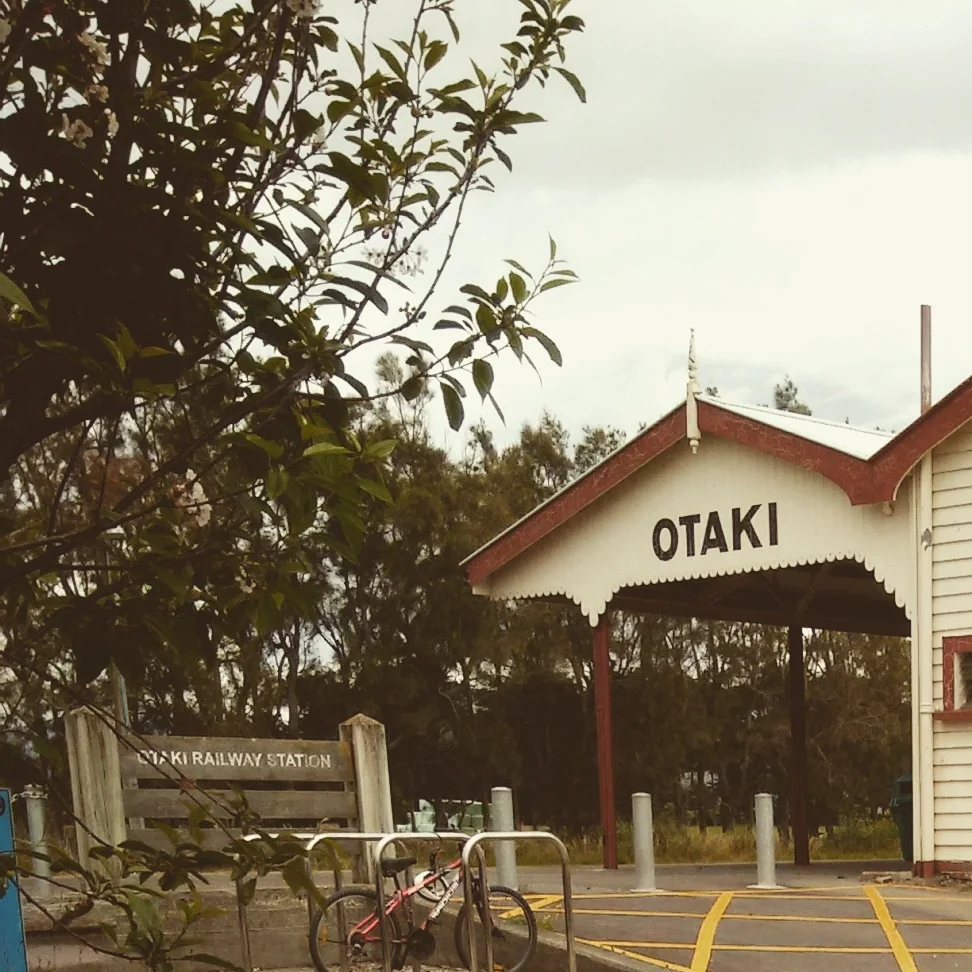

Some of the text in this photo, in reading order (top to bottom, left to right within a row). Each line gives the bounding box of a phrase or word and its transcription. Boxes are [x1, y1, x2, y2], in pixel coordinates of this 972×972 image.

[651, 502, 779, 562] OTAKI
[192, 750, 263, 767] RAILWAY
[267, 752, 332, 768] STATION
